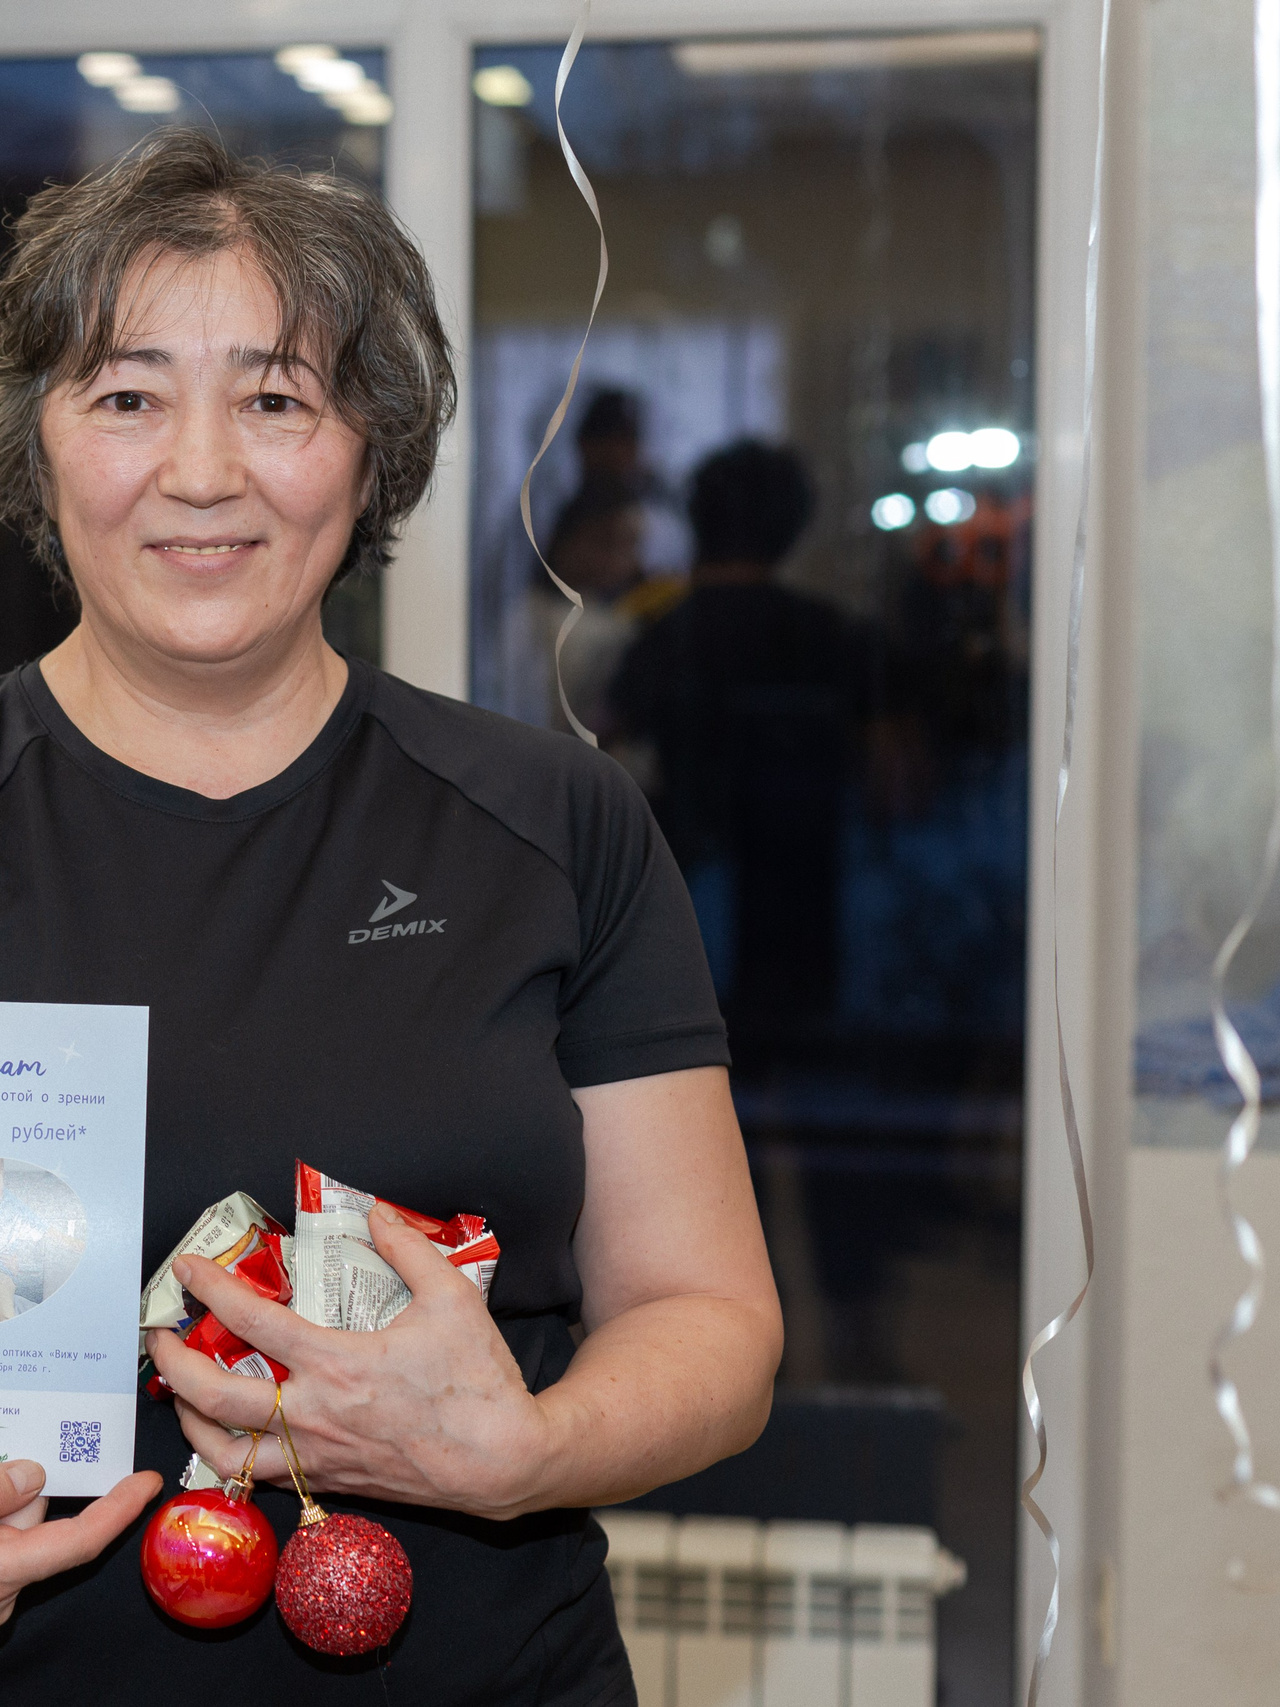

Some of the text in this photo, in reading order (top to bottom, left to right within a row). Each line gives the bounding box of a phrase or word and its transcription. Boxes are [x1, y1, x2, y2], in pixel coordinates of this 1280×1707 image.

[348, 919, 447, 944] DEMIX
[41, 1093, 49, 1103] о
[57, 1093, 105, 1107] зрении
[2, 1348, 44, 1358] оптиках
[49, 1349, 79, 1362] «Вижу
[83, 1352, 108, 1362] мир»
[17, 1363, 38, 1373] 2026
[41, 1365, 52, 1373] г.
